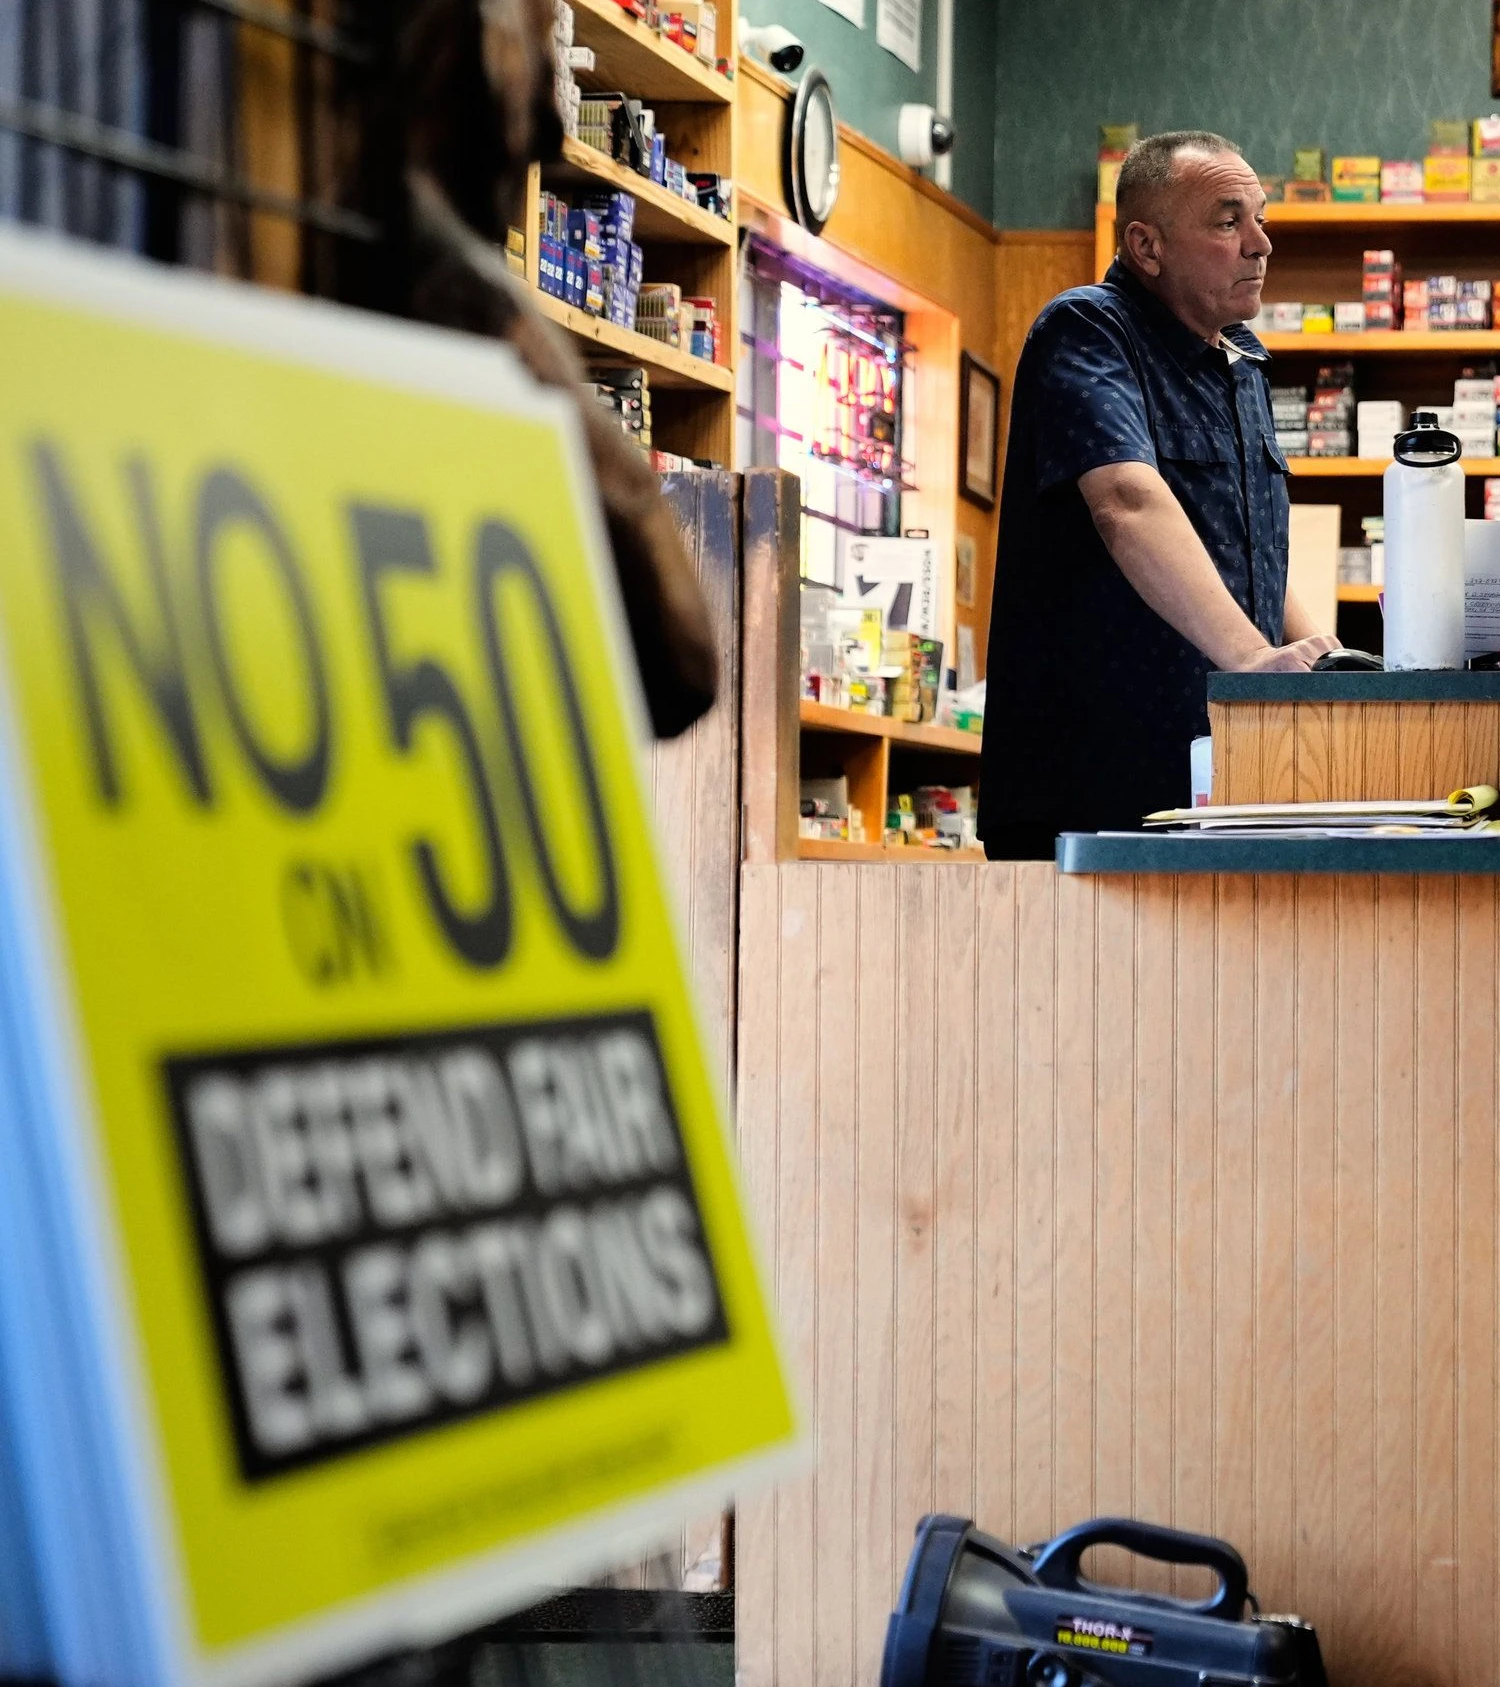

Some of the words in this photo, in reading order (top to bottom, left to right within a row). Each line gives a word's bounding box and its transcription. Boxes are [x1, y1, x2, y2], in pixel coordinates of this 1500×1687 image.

[27, 425, 334, 816] NO
[343, 498, 626, 972] 50
[185, 1048, 527, 1258] DEFEND
[514, 1024, 679, 1195] FAIR
[224, 1183, 719, 1460] ELECTIONS
[1073, 1616, 1132, 1642] THOR-X
